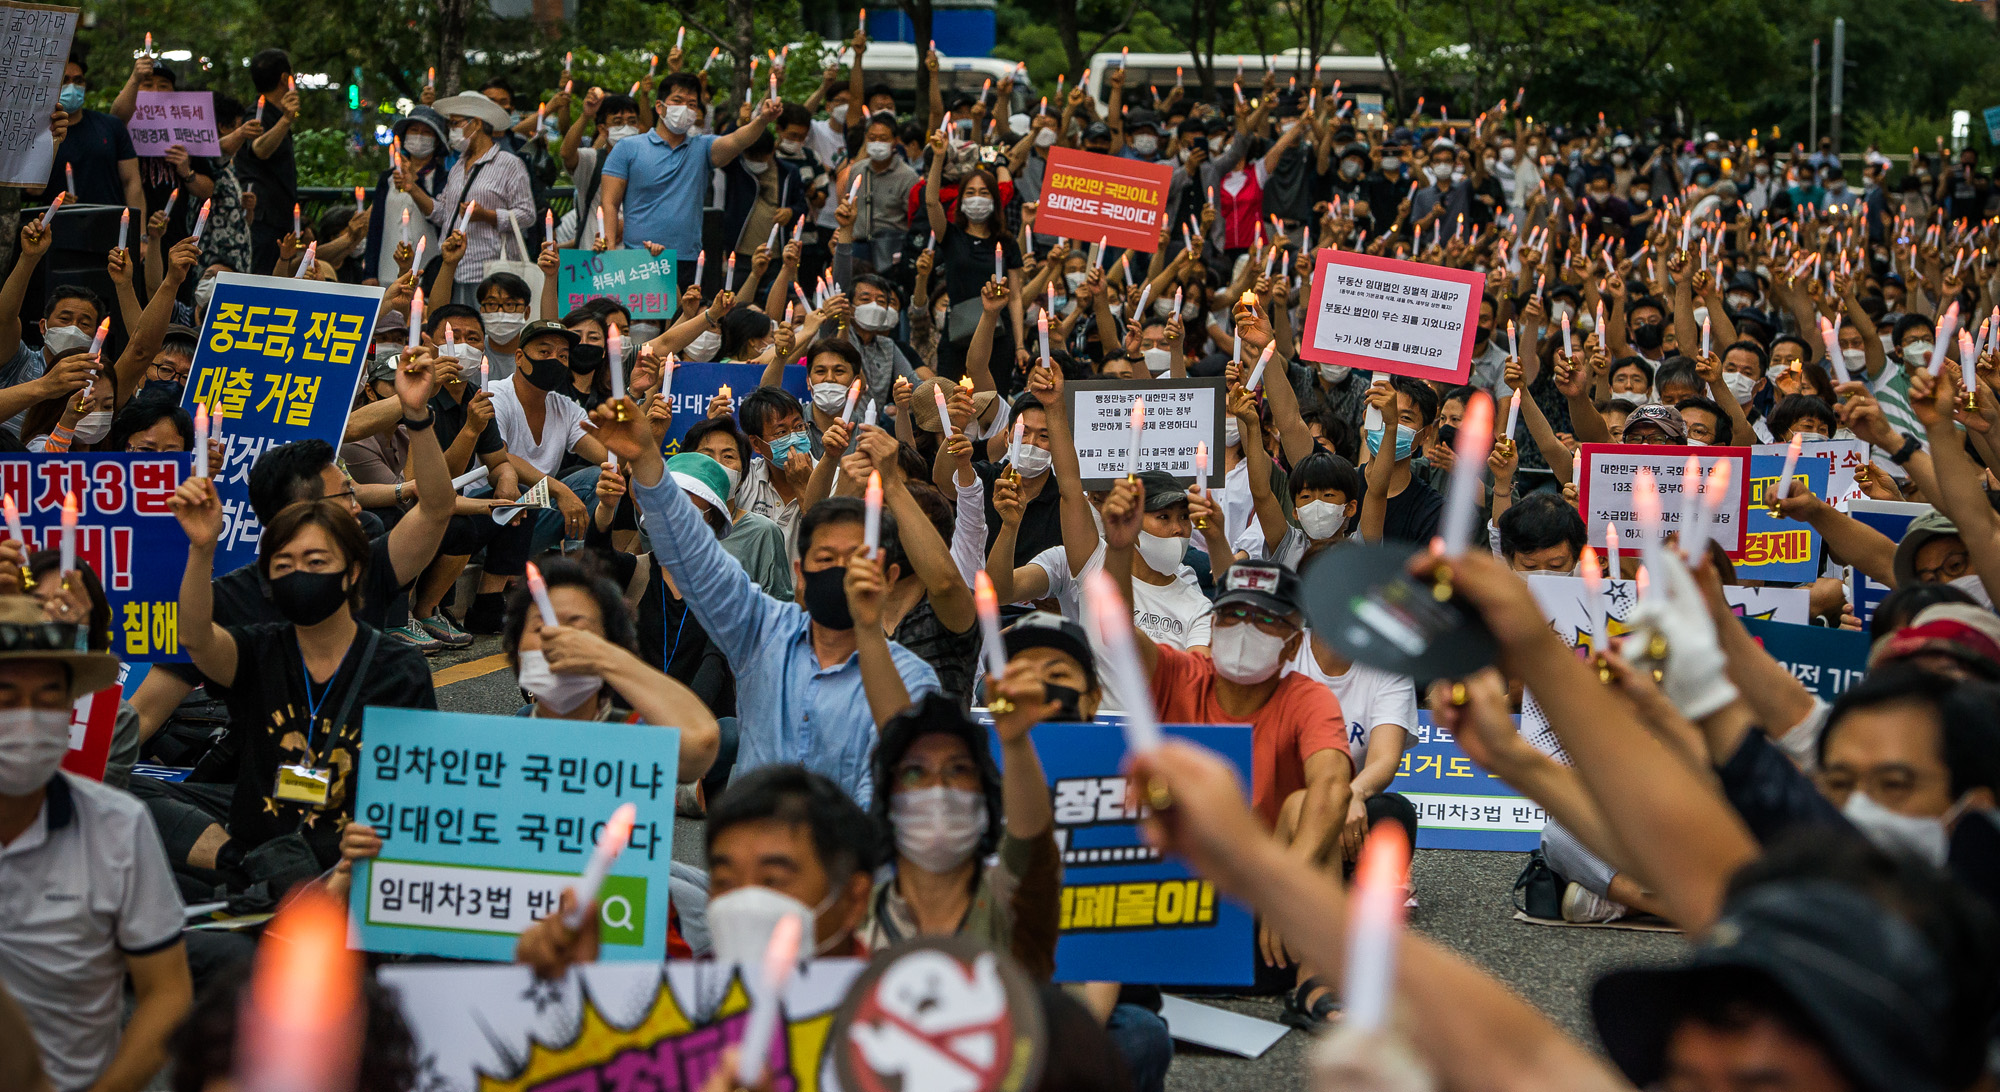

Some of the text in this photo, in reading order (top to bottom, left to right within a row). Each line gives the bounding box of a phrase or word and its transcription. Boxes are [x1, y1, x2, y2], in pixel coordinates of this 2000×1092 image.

[11, 9, 67, 36] 굶어가며
[4, 35, 60, 59] 세금내고
[169, 105, 204, 120] 취득세
[1051, 172, 1104, 196] 임차인만
[1047, 193, 1156, 225] 임대인도 국민이다!
[564, 256, 604, 283] 7.10
[592, 259, 671, 291] 취득세 소급적용
[1337, 275, 1363, 288] 부동산
[1365, 280, 1400, 294] 임대법인
[1402, 285, 1428, 298] 징벌적
[627, 293, 668, 313] 위헌!
[1325, 302, 1462, 332] 부동산 법인이 무슨 죄를 지었나요?
[209, 302, 365, 365] 중도금, 잔금
[1334, 333, 1443, 358] 누가 사형 선고를 내렸나요?
[192, 366, 322, 426] 대출 거절
[1145, 393, 1176, 403] 대한민국
[1179, 392, 1194, 402] 정부
[1097, 408, 1121, 417] 국민을
[1157, 407, 1173, 416] 아는
[1176, 406, 1191, 416] 정부
[1091, 422, 1123, 431] 방만하게
[1159, 420, 1198, 430] 운영하더니
[1079, 448, 1102, 458] 칼들고
[1107, 448, 1115, 458] 돈
[1151, 447, 1175, 457] 결국엔
[1145, 461, 1168, 470] 징벌적
[1600, 464, 1639, 476] 대한민국
[1641, 465, 1663, 477] 정부,
[1666, 466, 1704, 477] 국회원
[1612, 482, 1633, 492] 13조
[1733, 530, 1811, 565] 경제!
[123, 601, 178, 655] 침해
[1133, 609, 1183, 635] AROO
[373, 744, 664, 800] 임차인만 국민이냐
[366, 802, 501, 845] 임대인도
[1412, 802, 1502, 823] 임대차3법
[379, 878, 566, 922] 임대차3법 반
